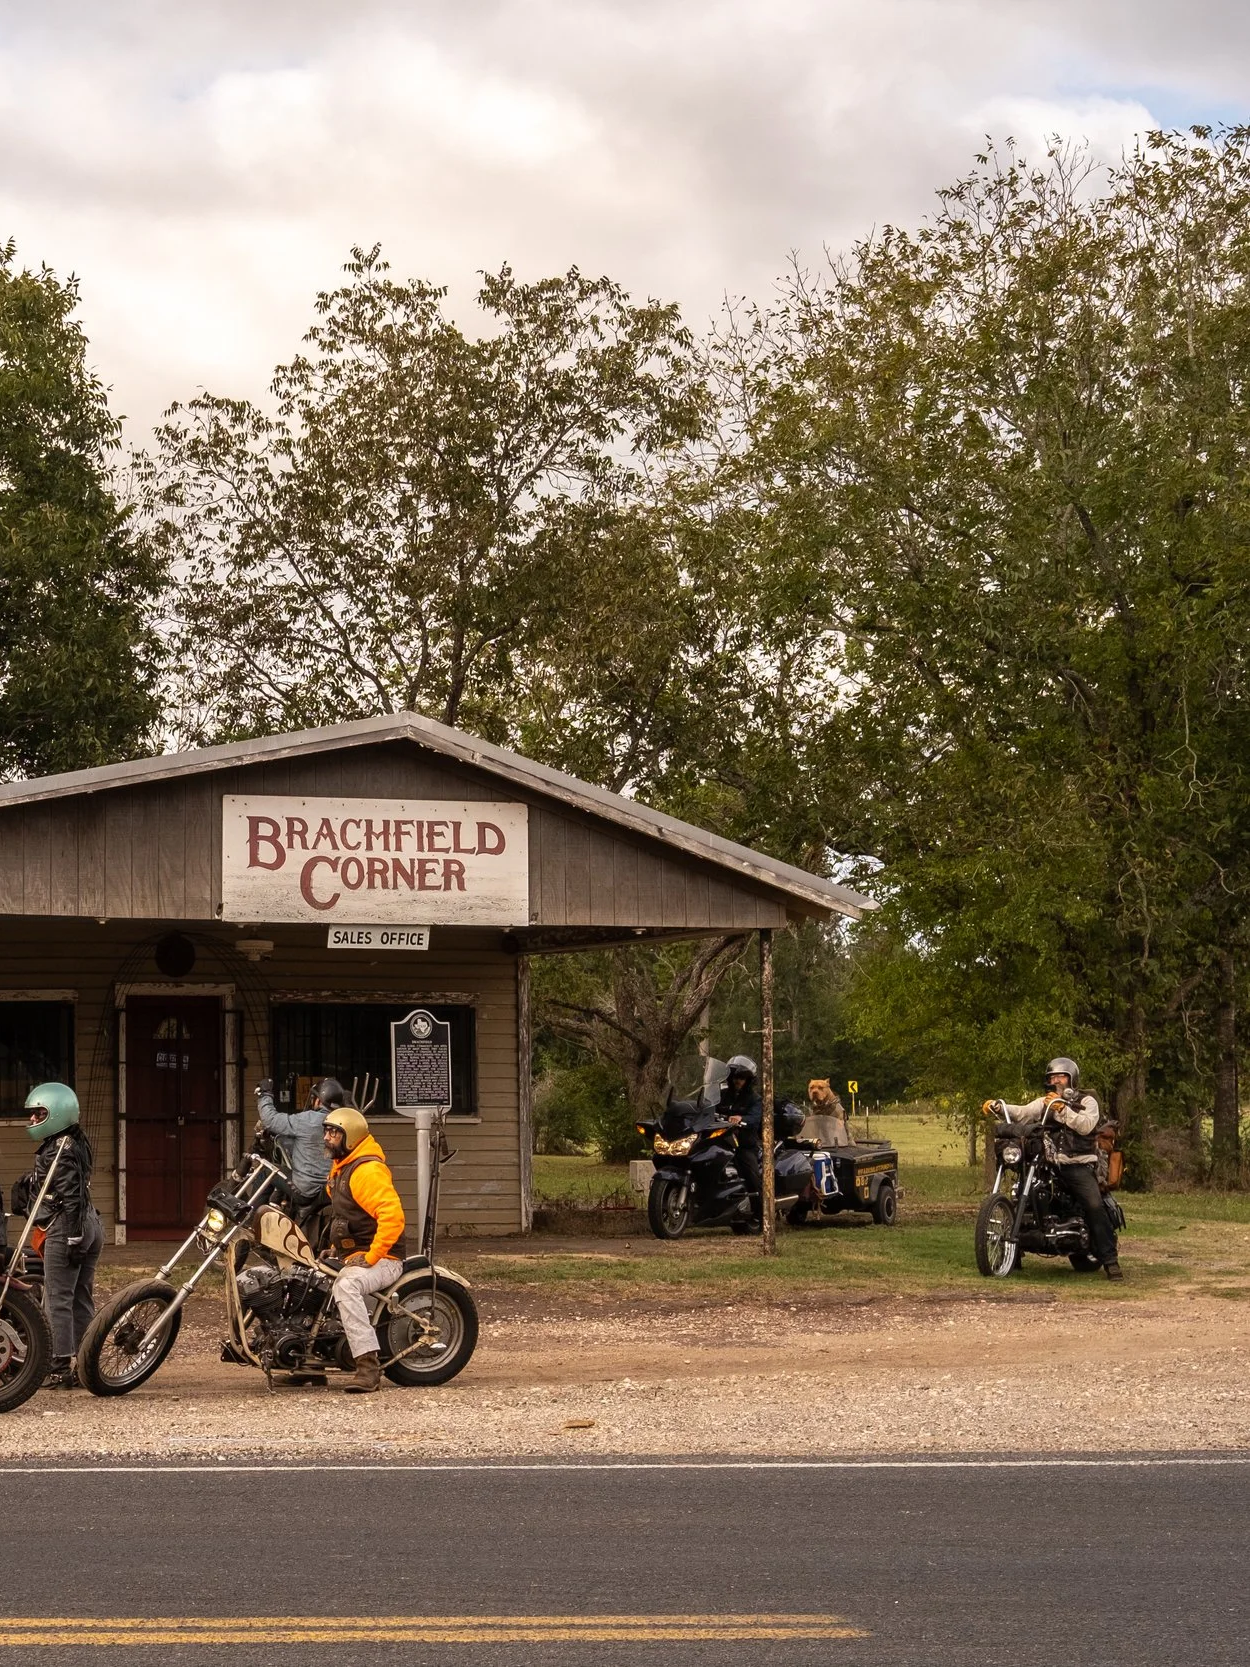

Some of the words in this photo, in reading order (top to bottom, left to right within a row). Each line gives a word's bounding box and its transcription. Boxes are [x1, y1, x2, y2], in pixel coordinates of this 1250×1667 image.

[246, 815, 506, 871] BRACHFIELD
[300, 855, 467, 911] CORNER
[333, 930, 372, 944] SALES
[380, 931, 424, 946] OFFICE
